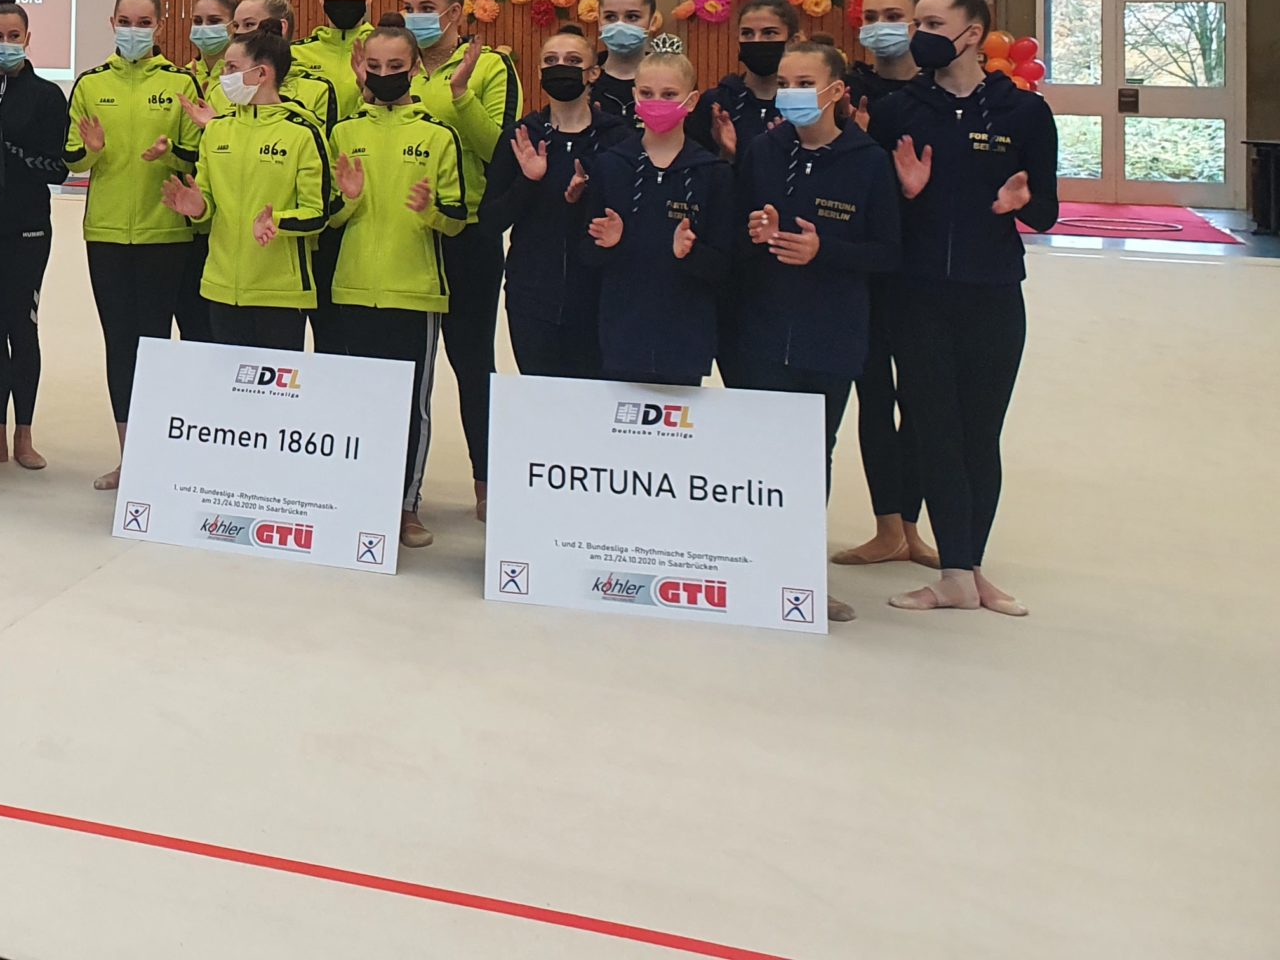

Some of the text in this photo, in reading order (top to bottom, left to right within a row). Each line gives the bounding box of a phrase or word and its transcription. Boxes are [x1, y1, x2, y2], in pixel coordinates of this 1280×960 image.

[257, 366, 301, 389] DTL
[641, 404, 694, 428] DTL
[168, 416, 268, 450] Bremen
[278, 429, 335, 457] 1860
[200, 487, 234, 499] Bundesliga
[528, 462, 785, 508] FORTUNA Berlin
[266, 505, 308, 516] Saarbrücken
[255, 523, 314, 550] GTÜ
[577, 541, 585, 549] 2.
[586, 542, 629, 554] Bundesliga
[668, 559, 719, 572] Saarbrücken
[659, 579, 728, 608] GTÜ
